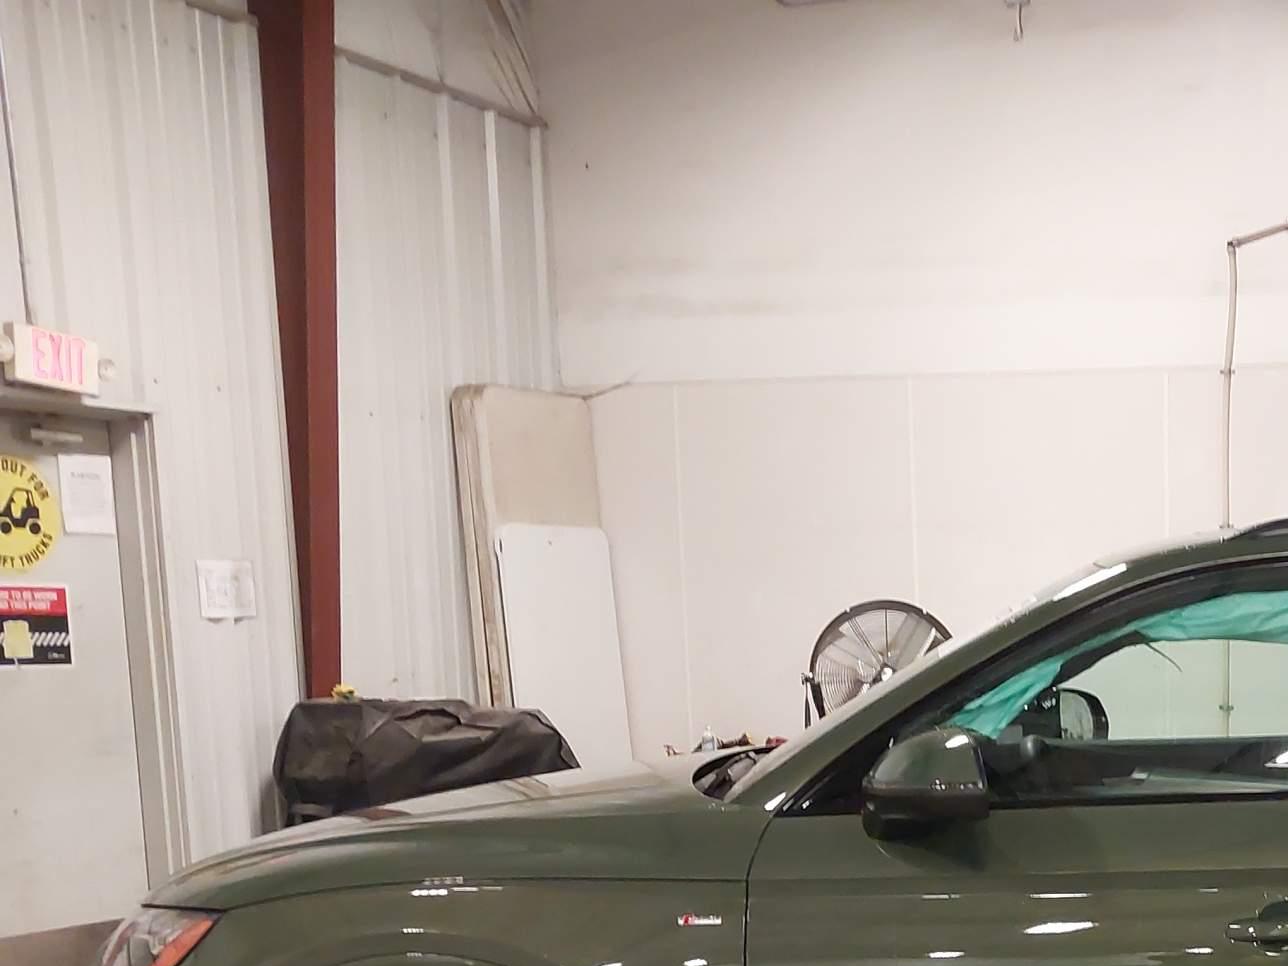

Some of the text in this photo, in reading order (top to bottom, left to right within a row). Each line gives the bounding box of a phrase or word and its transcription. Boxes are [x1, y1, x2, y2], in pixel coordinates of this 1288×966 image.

[31, 328, 87, 386] EXIT
[1, 459, 27, 478] OUT
[19, 533, 53, 568] TRUCKS
